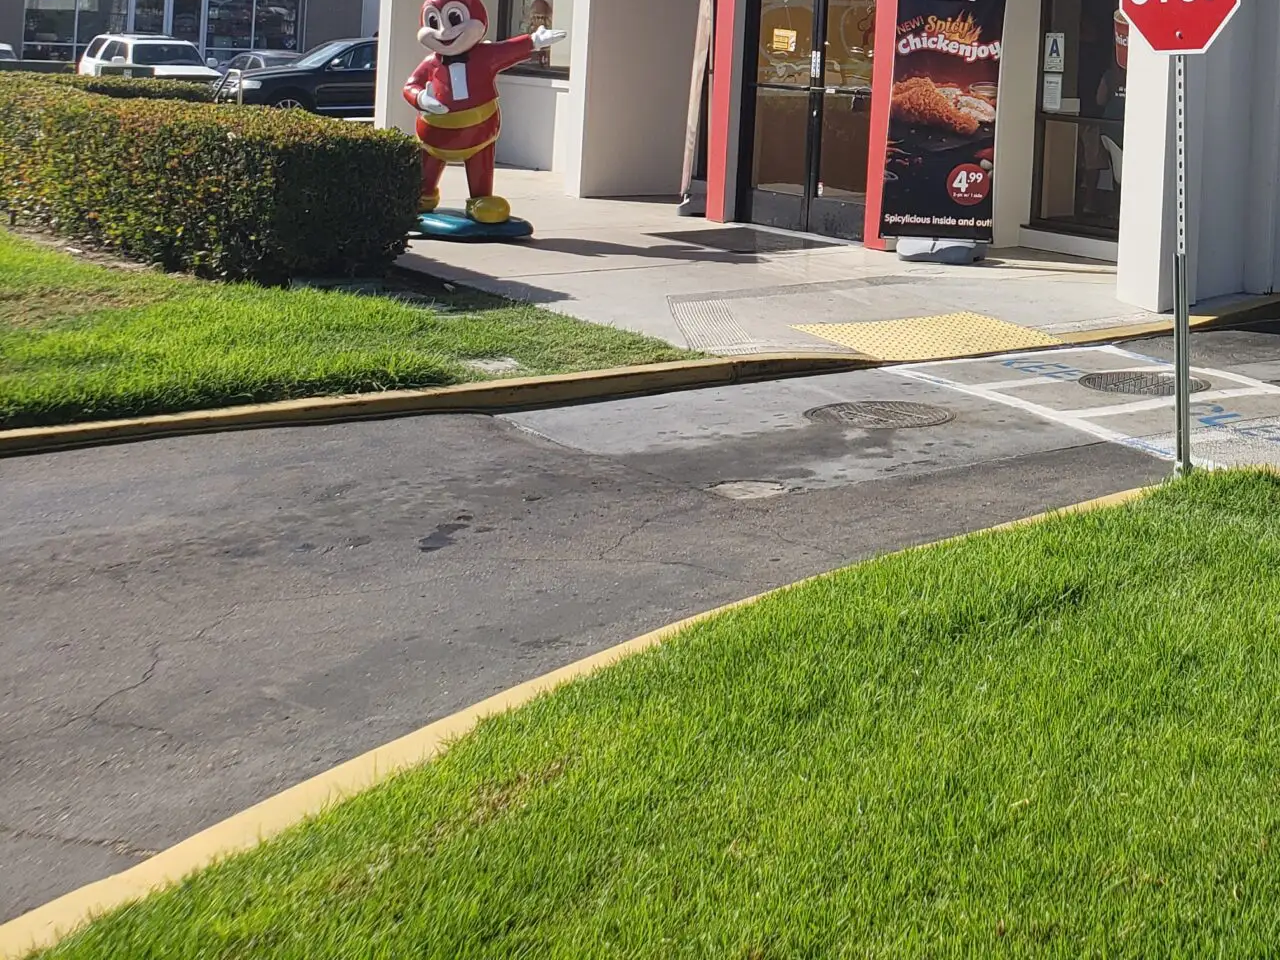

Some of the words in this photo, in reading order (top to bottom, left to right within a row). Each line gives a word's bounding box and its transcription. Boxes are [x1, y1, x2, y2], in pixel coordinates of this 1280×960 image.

[897, 15, 924, 35] NEW!
[925, 15, 969, 39] Spicy
[897, 32, 1002, 62] Chickenjoy
[1049, 38, 1060, 57] A
[952, 170, 983, 193] 4.99
[884, 214, 931, 225] Spicylicious
[932, 215, 957, 225] inside
[958, 217, 974, 227] and
[976, 219, 992, 227] out!
[1000, 357, 1091, 382] KEE
